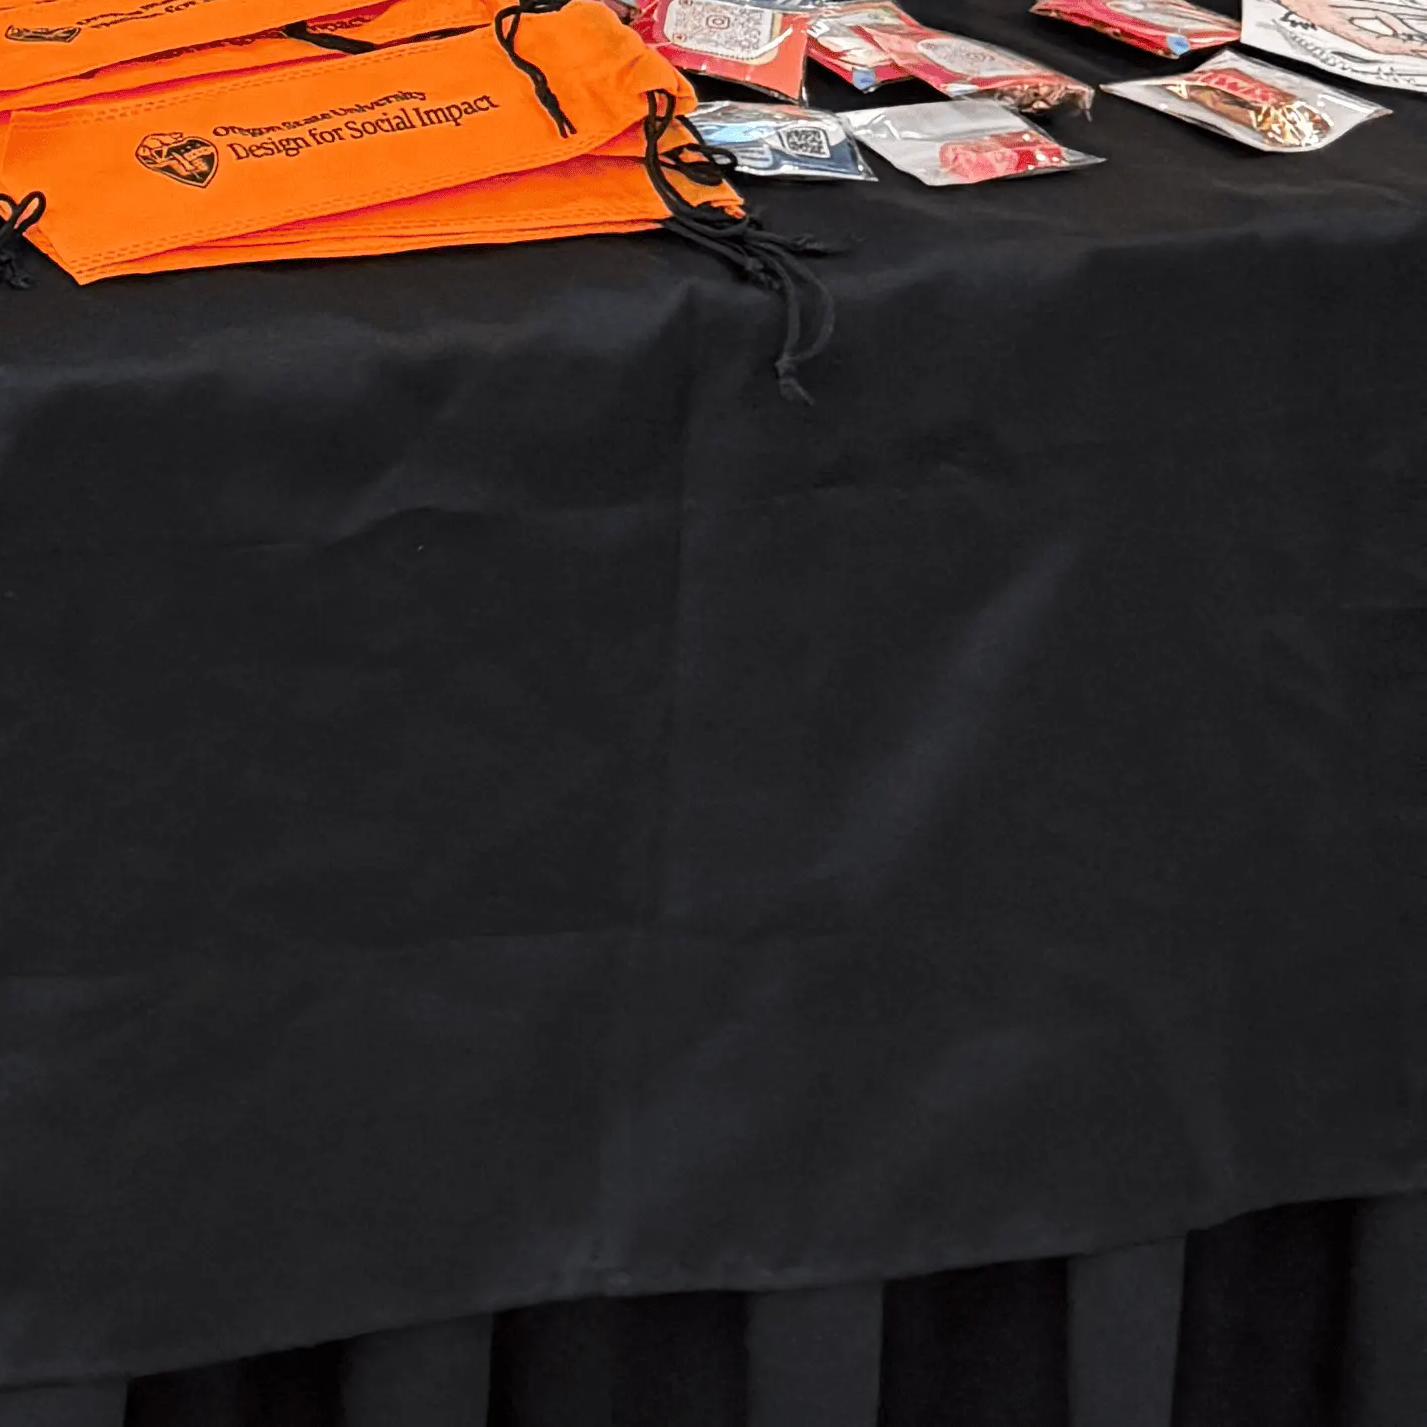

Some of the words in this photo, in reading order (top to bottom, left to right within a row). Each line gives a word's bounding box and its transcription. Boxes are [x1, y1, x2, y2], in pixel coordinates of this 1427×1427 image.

[227, 132, 310, 161] Design
[309, 125, 343, 146] for
[345, 110, 414, 138] Social
[414, 94, 501, 127] Impact
